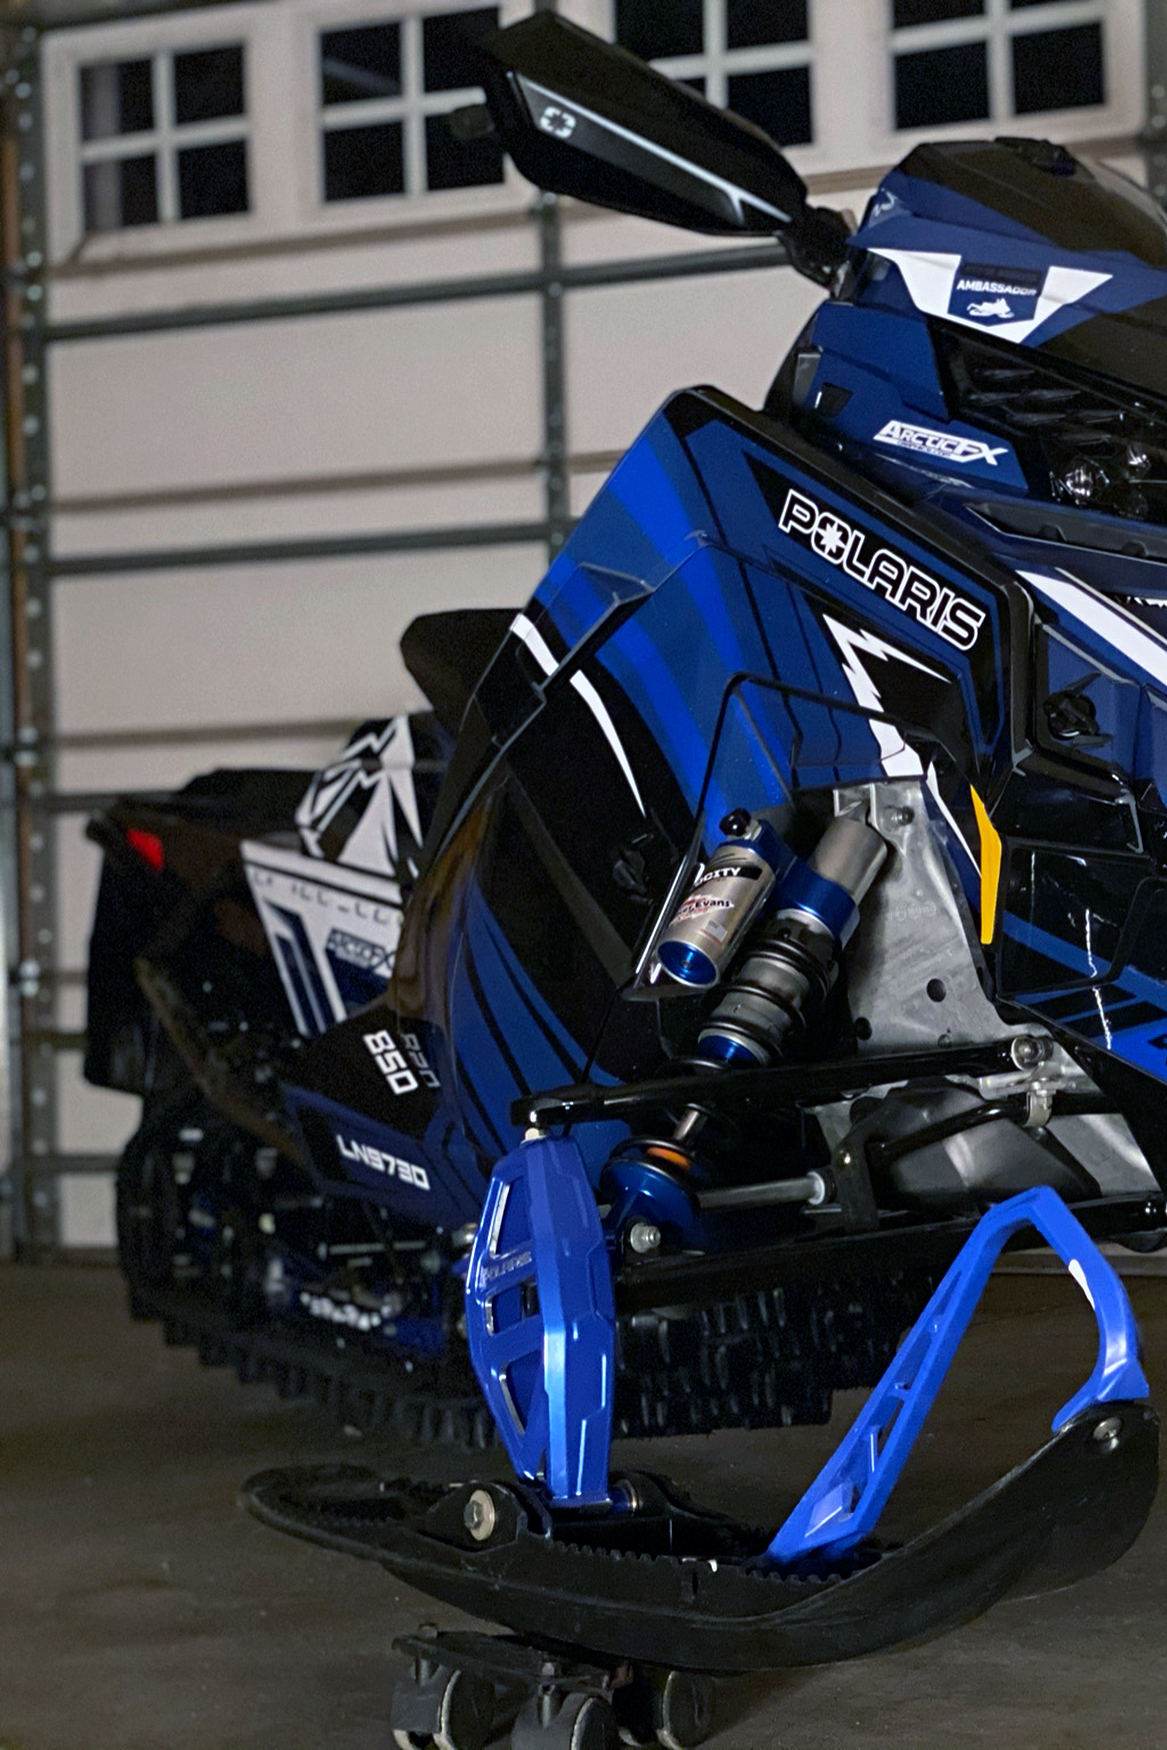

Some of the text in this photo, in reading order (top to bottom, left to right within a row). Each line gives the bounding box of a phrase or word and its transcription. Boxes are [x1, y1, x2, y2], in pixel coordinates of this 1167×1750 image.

[955, 278, 1038, 297] AMBASSADOR
[778, 488, 987, 652] POLARIS
[361, 1028, 420, 1096] 850
